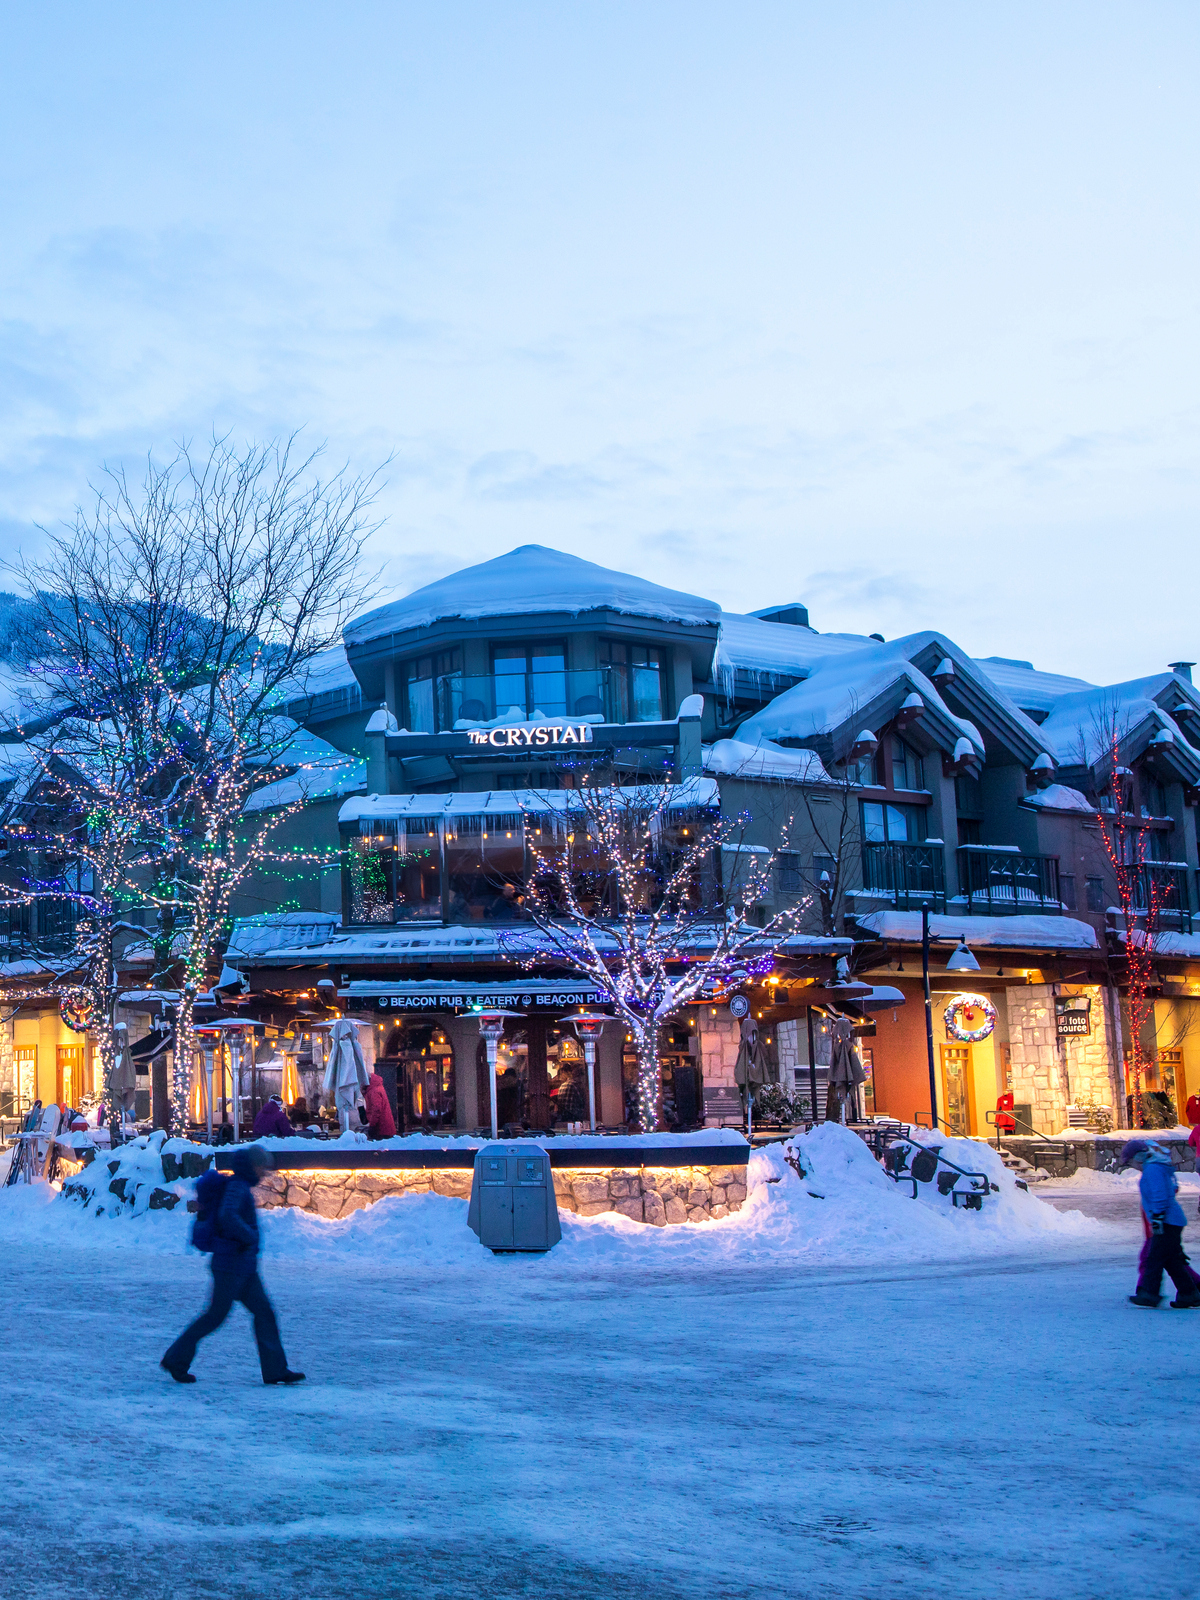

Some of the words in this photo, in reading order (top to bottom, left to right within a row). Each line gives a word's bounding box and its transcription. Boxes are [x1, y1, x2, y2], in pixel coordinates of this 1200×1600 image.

[467, 731, 488, 744] The
[390, 996, 437, 1007] BEACON
[440, 996, 463, 1006] PUB
[466, 996, 474, 1006] &
[476, 995, 520, 1006] EATERY
[536, 994, 583, 1005] BEACON
[587, 994, 611, 1003] PUB
[1069, 1016, 1086, 1025] foto
[1058, 1024, 1087, 1033] source
